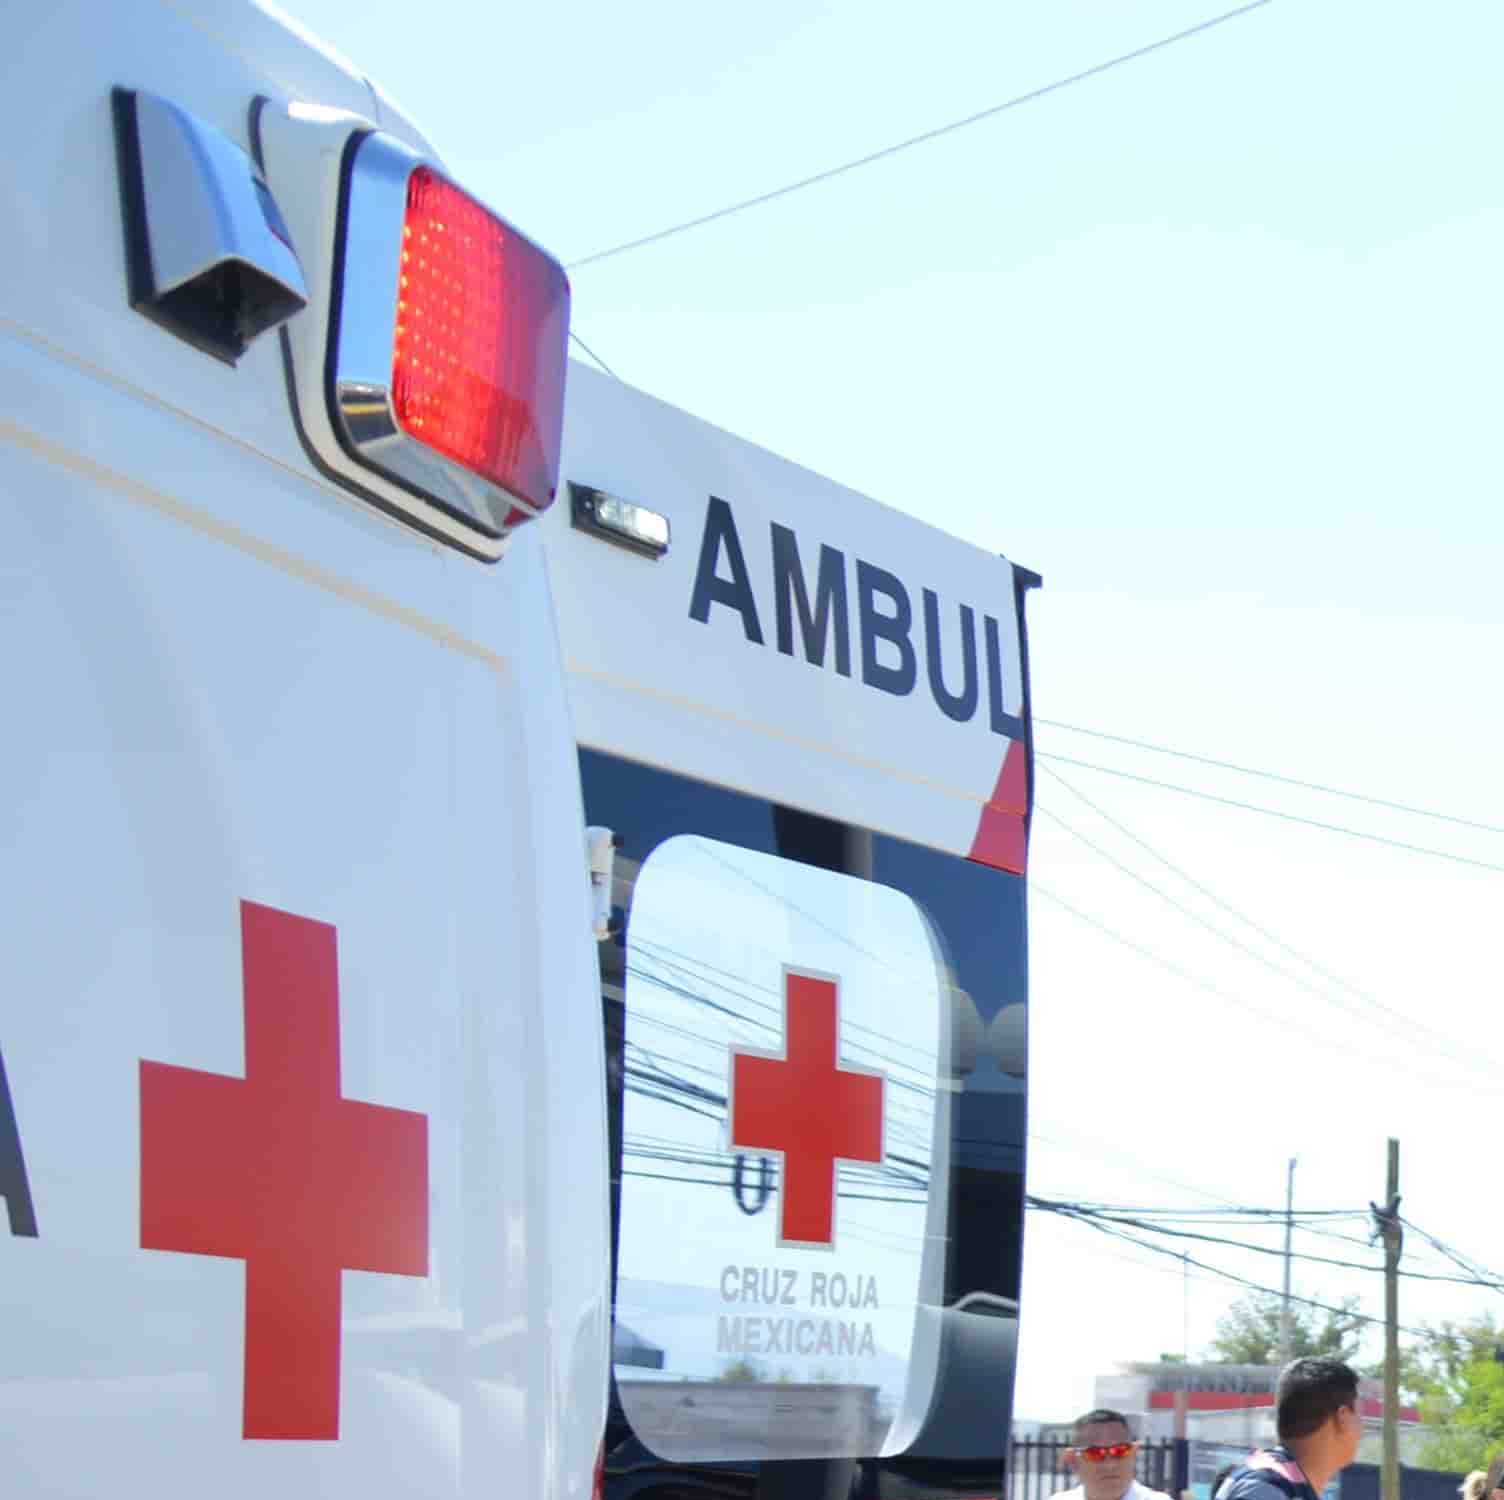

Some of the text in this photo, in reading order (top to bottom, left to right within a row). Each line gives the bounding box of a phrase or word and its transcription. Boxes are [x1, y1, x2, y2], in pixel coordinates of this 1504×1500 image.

[720, 1265, 880, 1310] CRUZ ROJA
[716, 1315, 877, 1357] MEXICANA
